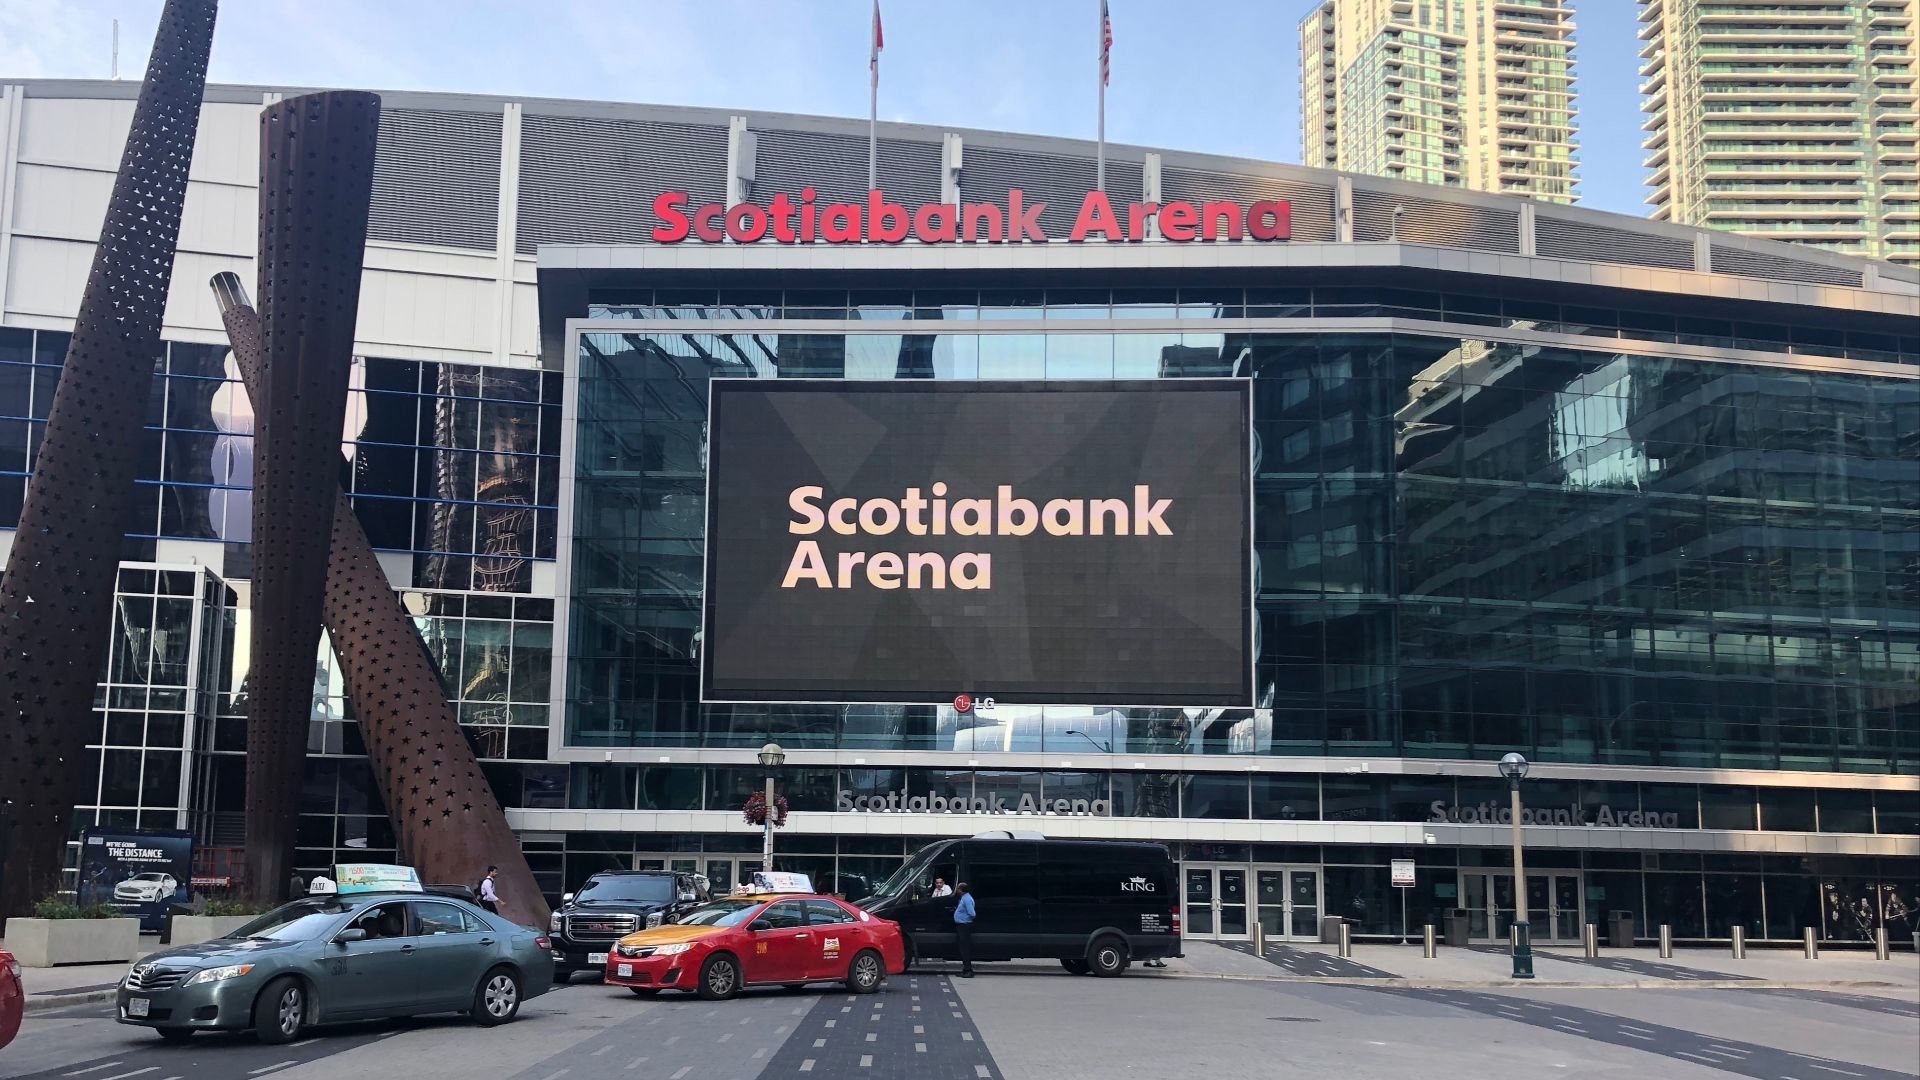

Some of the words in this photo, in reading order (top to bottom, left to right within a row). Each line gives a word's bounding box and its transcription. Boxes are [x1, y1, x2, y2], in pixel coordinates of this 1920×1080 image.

[652, 187, 1048, 243] Scotiabank
[1068, 191, 1292, 242] Arena
[788, 482, 1174, 536] Scotiabank
[781, 540, 992, 590] Arena
[975, 697, 995, 709] LG
[837, 790, 1007, 814] Scotiabank
[1016, 793, 1110, 816] Arena
[1430, 800, 1586, 827] Scotiabank
[1596, 804, 1679, 828] Arena
[109, 848, 124, 857] THE
[125, 849, 163, 858] DISTANCE
[312, 882, 325, 890] TAXI
[1120, 882, 1155, 892] KING
